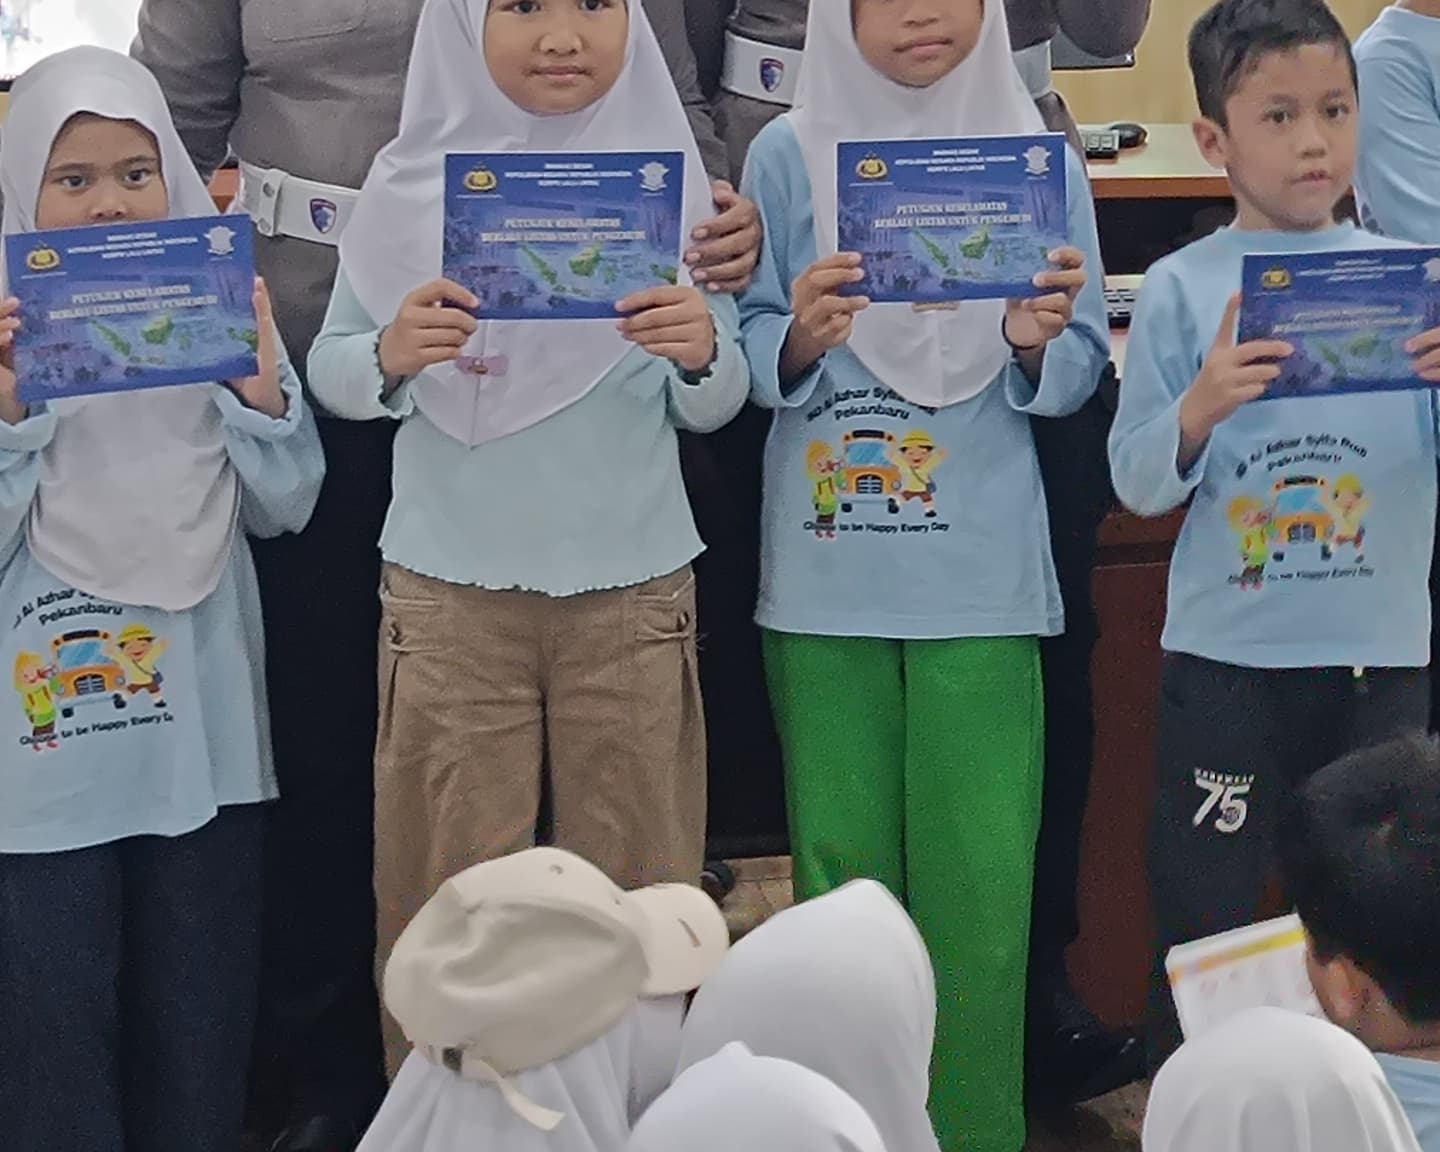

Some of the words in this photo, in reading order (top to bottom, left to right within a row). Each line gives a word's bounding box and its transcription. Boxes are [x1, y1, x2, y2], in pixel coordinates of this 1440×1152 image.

[834, 404, 911, 421] Pekanbaru
[866, 522, 899, 534] Happy
[900, 523, 929, 534] Every
[931, 522, 950, 532] Day
[36, 588, 77, 608] Azhar
[38, 603, 124, 626] Pekanbaru
[76, 725, 89, 735] be
[91, 717, 129, 732] Happy
[130, 713, 162, 727] Every
[1192, 777, 1252, 833] 75
